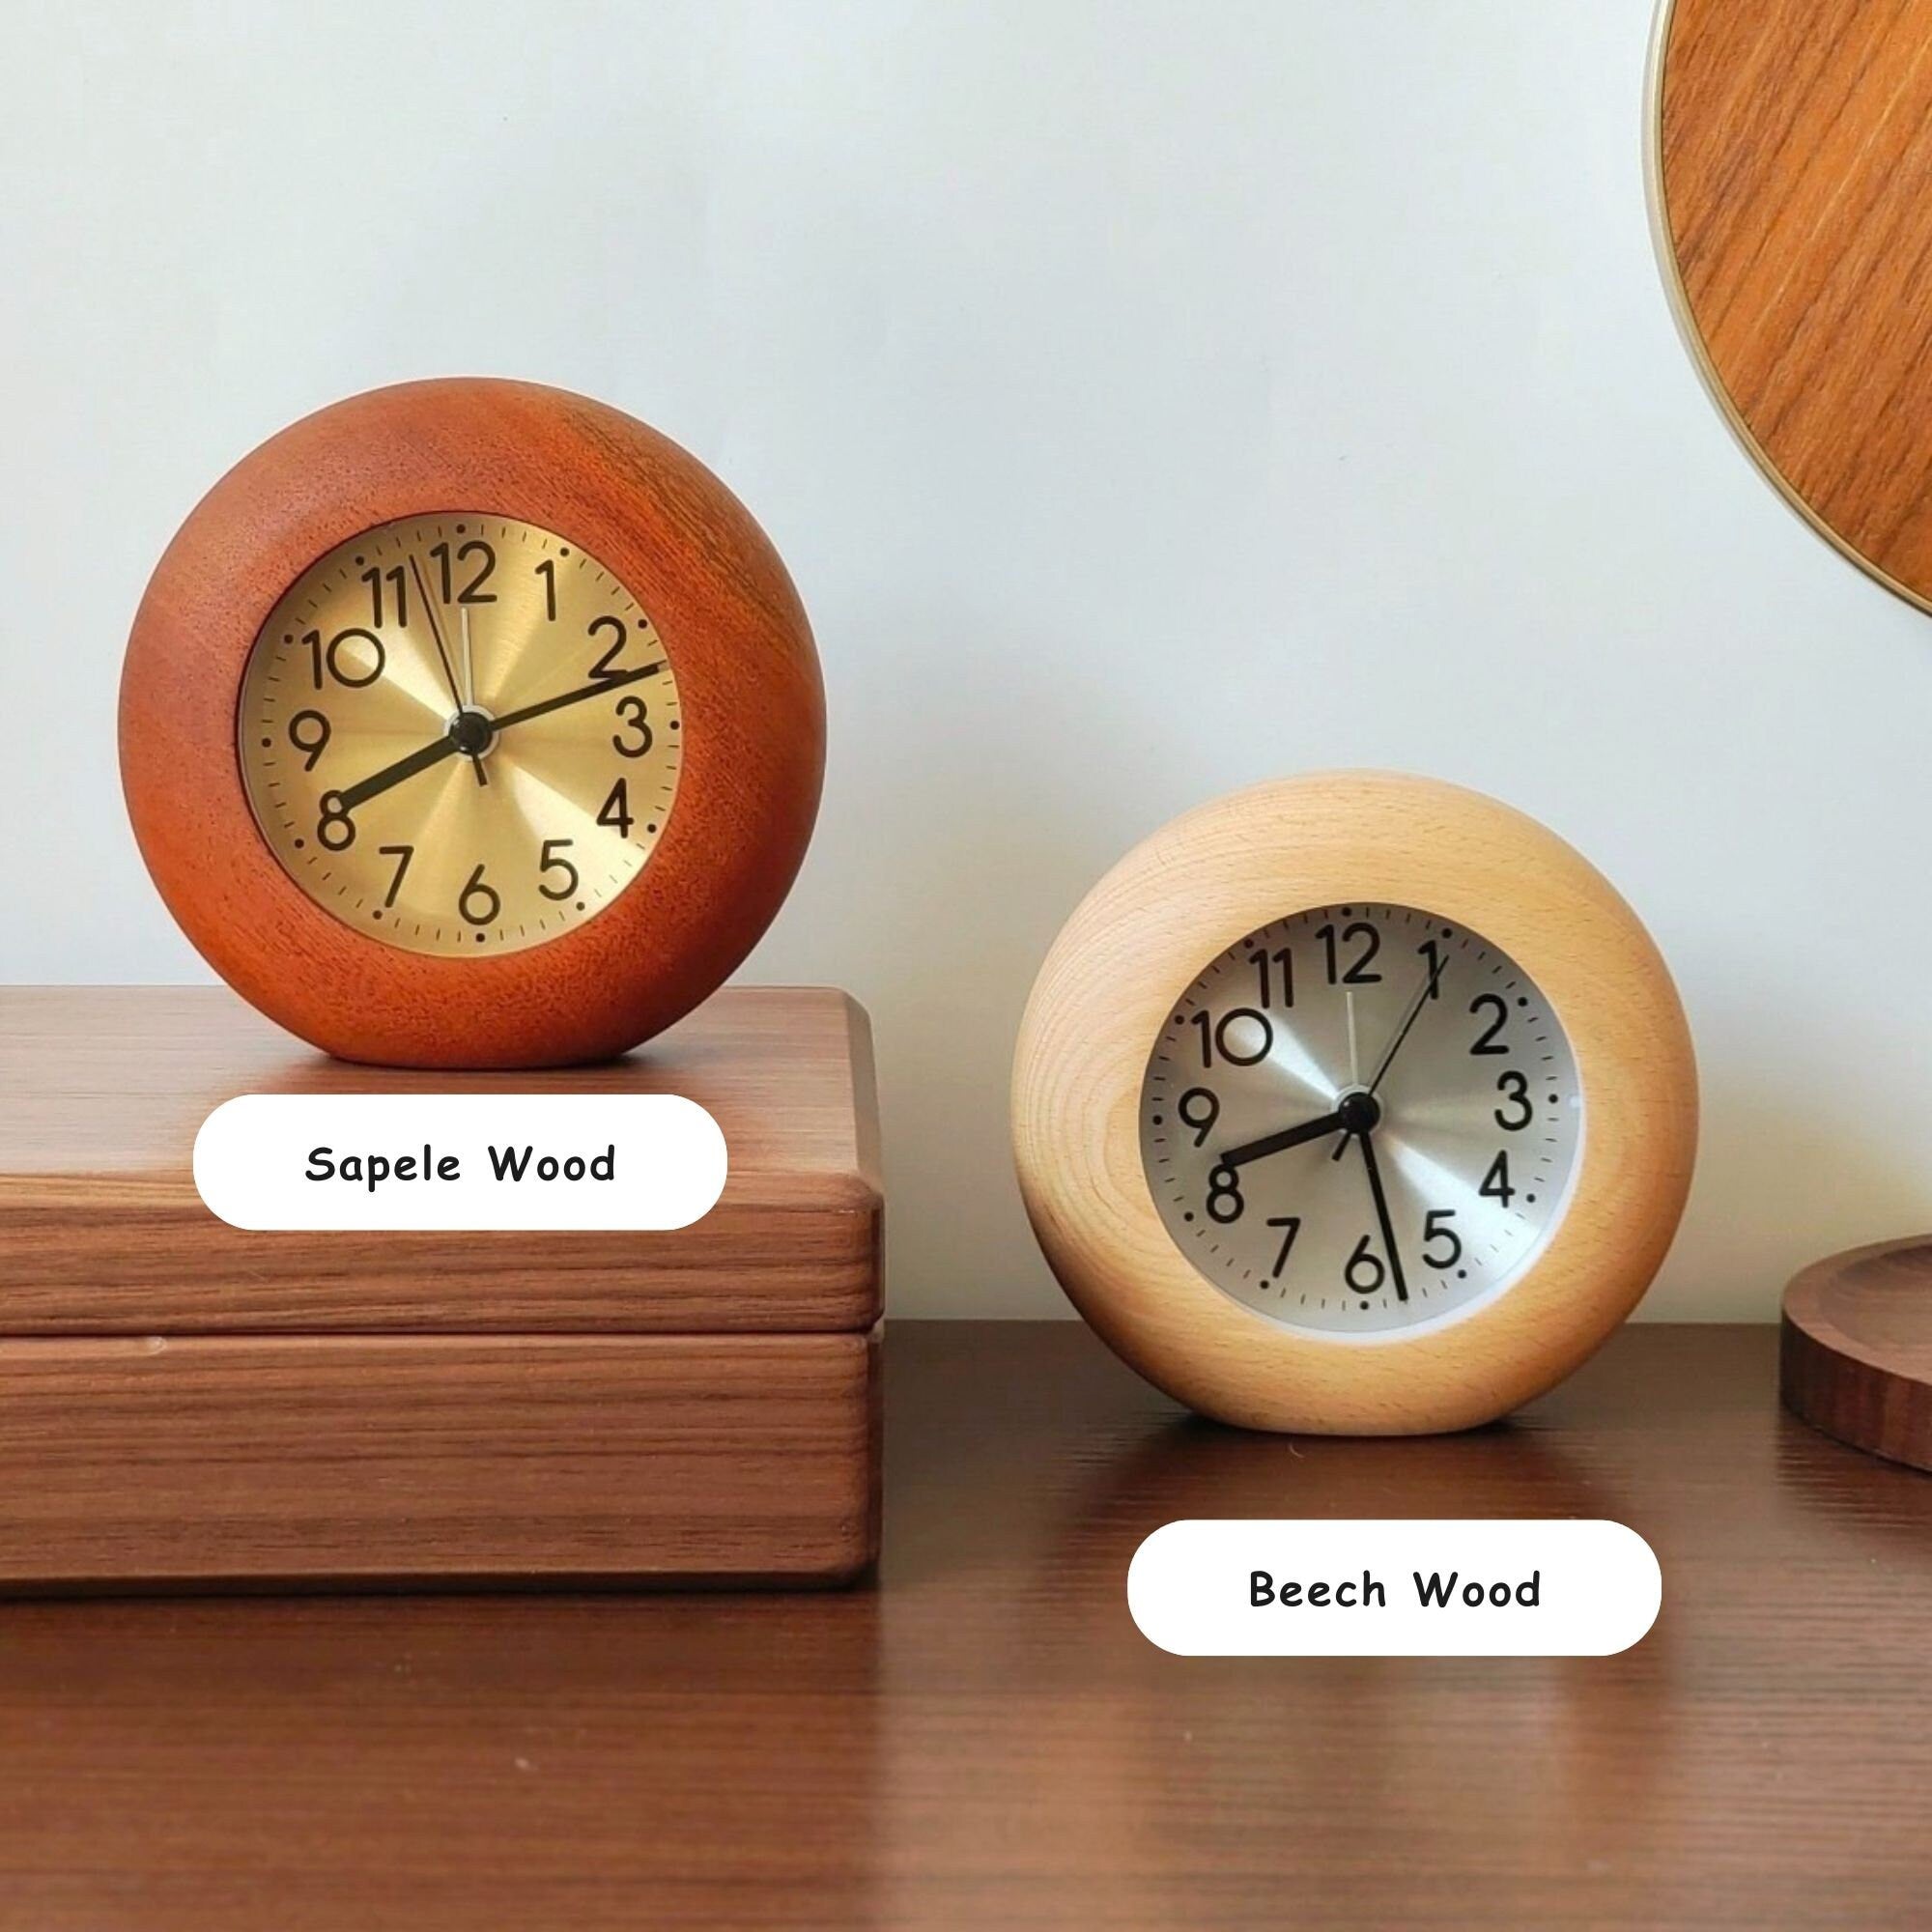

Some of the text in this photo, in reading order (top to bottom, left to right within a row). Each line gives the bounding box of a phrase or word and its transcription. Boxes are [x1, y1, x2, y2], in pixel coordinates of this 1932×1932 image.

[362, 565, 407, 628] 11
[430, 541, 497, 604] 12
[535, 560, 556, 621] 1
[301, 629, 385, 690] 10
[588, 615, 628, 679] 2
[290, 710, 331, 772] 9
[613, 696, 652, 757] 3
[317, 789, 355, 851] 8
[597, 778, 634, 838] 4
[379, 846, 413, 908] 7
[459, 865, 500, 925] 6
[538, 839, 579, 901] 5
[1249, 948, 1293, 1009] 11
[1315, 923, 1381, 984] 12
[1418, 940, 1438, 1000] 1
[1191, 1008, 1273, 1068] 10
[1469, 993, 1510, 1055] 2
[1178, 1088, 1220, 1148] 9
[1494, 1070, 1533, 1131] 3
[1207, 1164, 1244, 1224] 8
[1479, 1150, 1516, 1208] 4
[1266, 1217, 1300, 1278] 7
[1345, 1235, 1385, 1294] 6
[1422, 1209, 1463, 1269] 5
